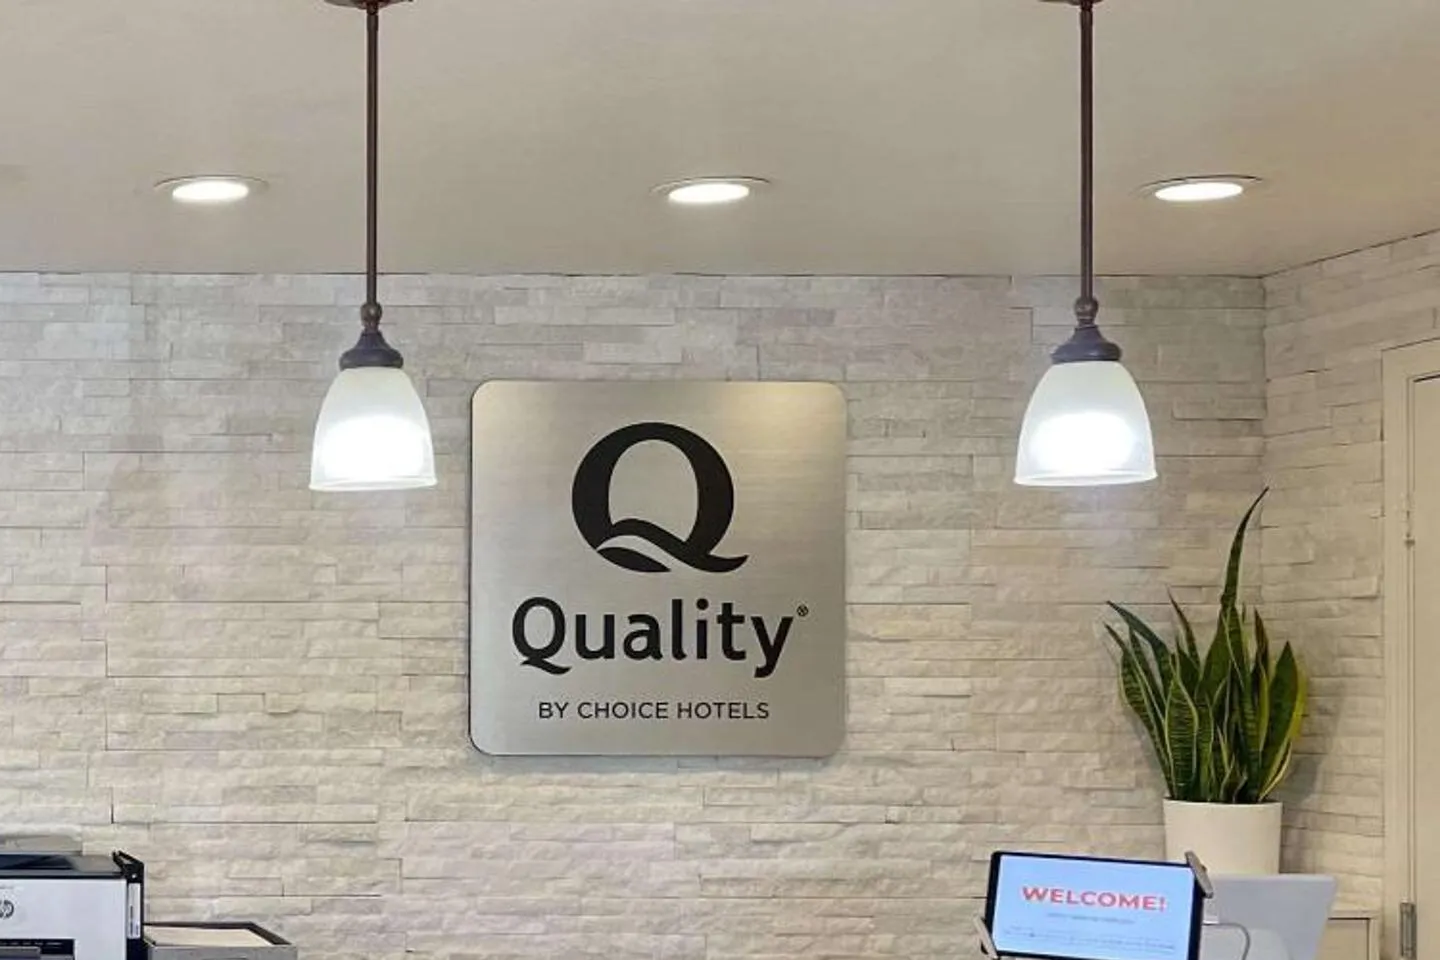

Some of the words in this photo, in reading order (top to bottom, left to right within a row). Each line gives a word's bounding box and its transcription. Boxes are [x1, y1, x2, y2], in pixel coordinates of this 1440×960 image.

[571, 421, 749, 573] Q
[538, 702, 569, 719] BY
[577, 701, 669, 719] CHOICE
[677, 701, 770, 719] HOTELS
[1021, 886, 1167, 912] WELCOME!
